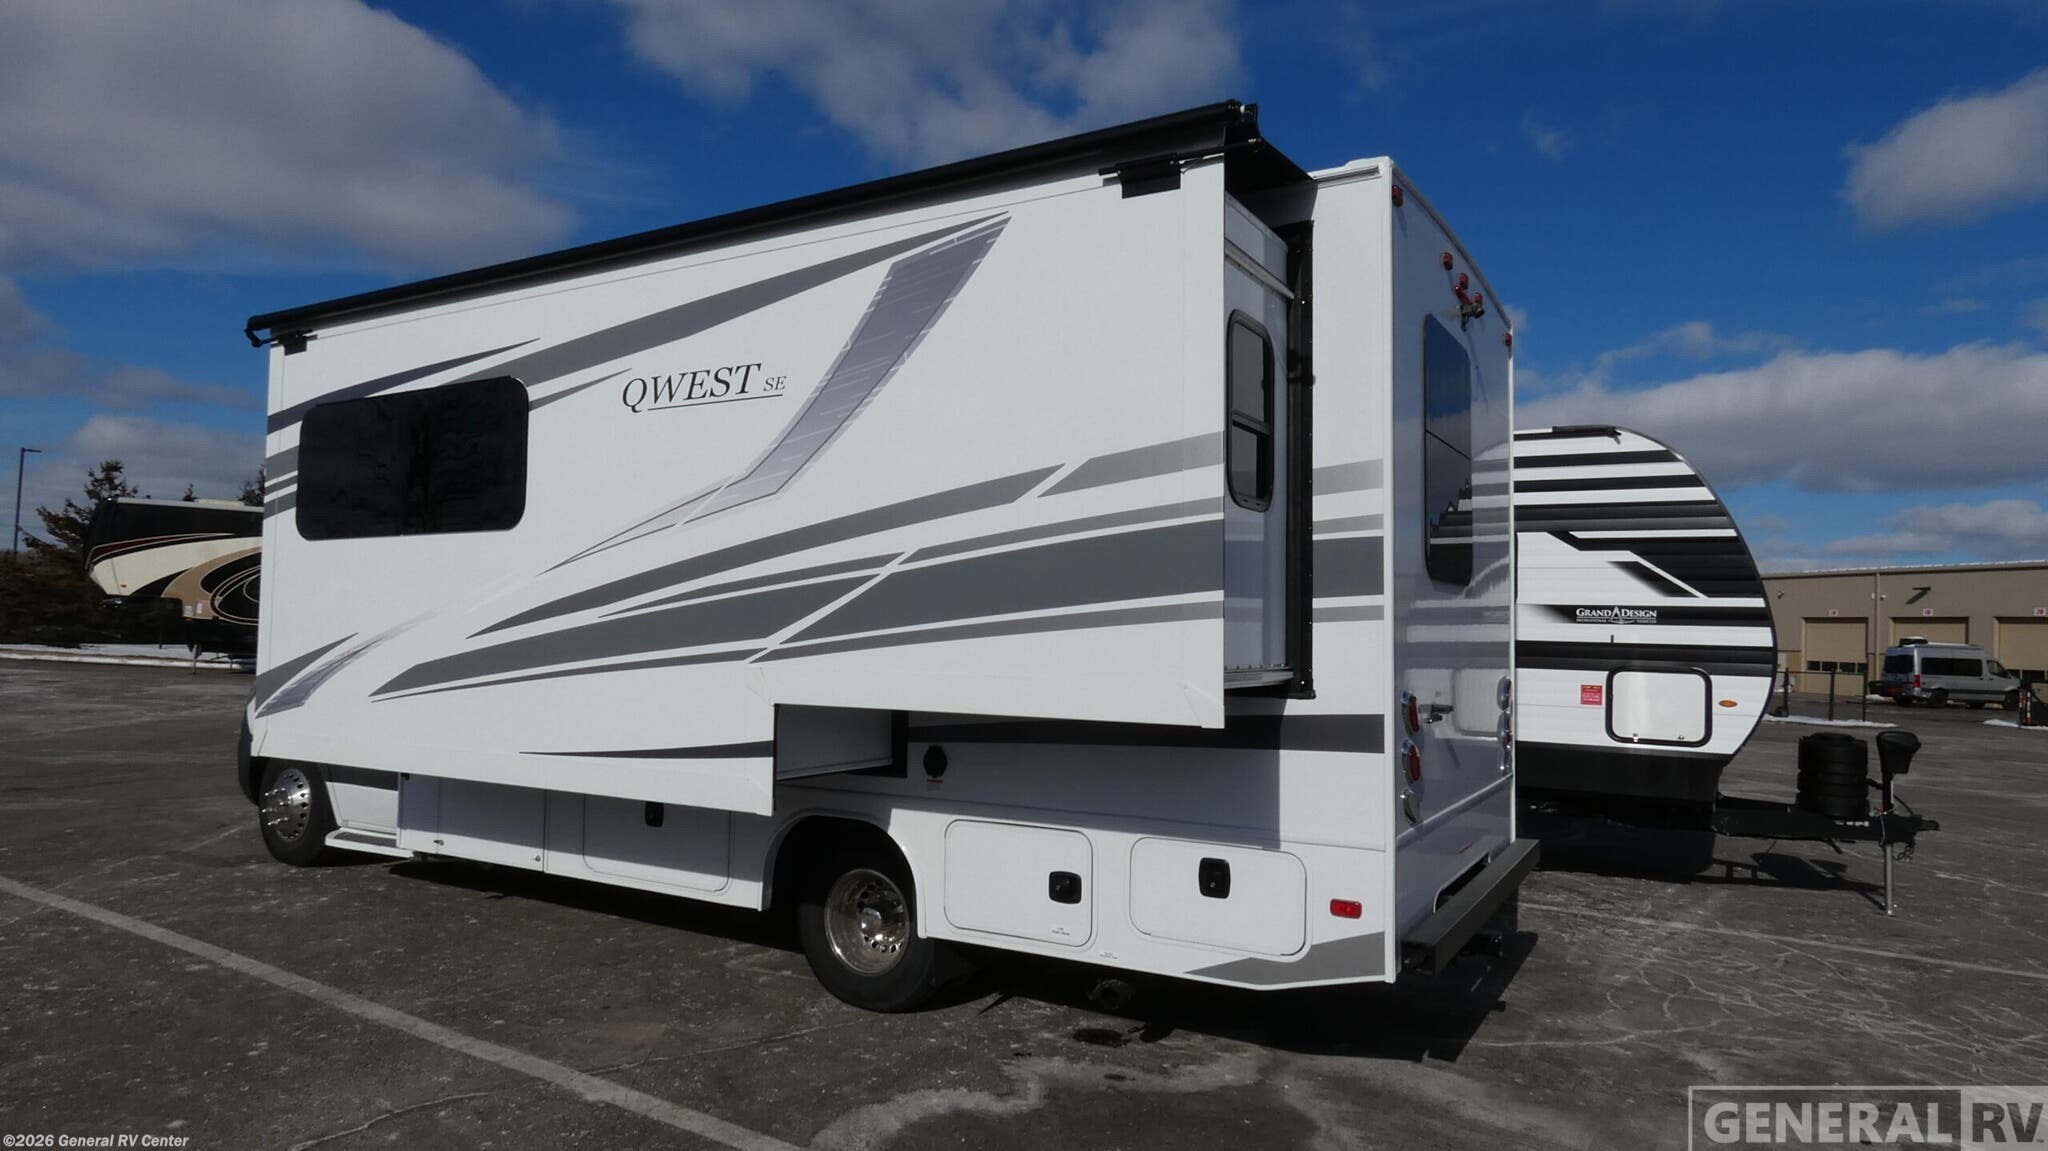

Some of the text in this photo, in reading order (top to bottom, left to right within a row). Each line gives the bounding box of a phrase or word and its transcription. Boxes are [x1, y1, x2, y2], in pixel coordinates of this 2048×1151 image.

[622, 363, 787, 413] QWEST SE
[1576, 608, 1657, 617] GRAND DESIGN
